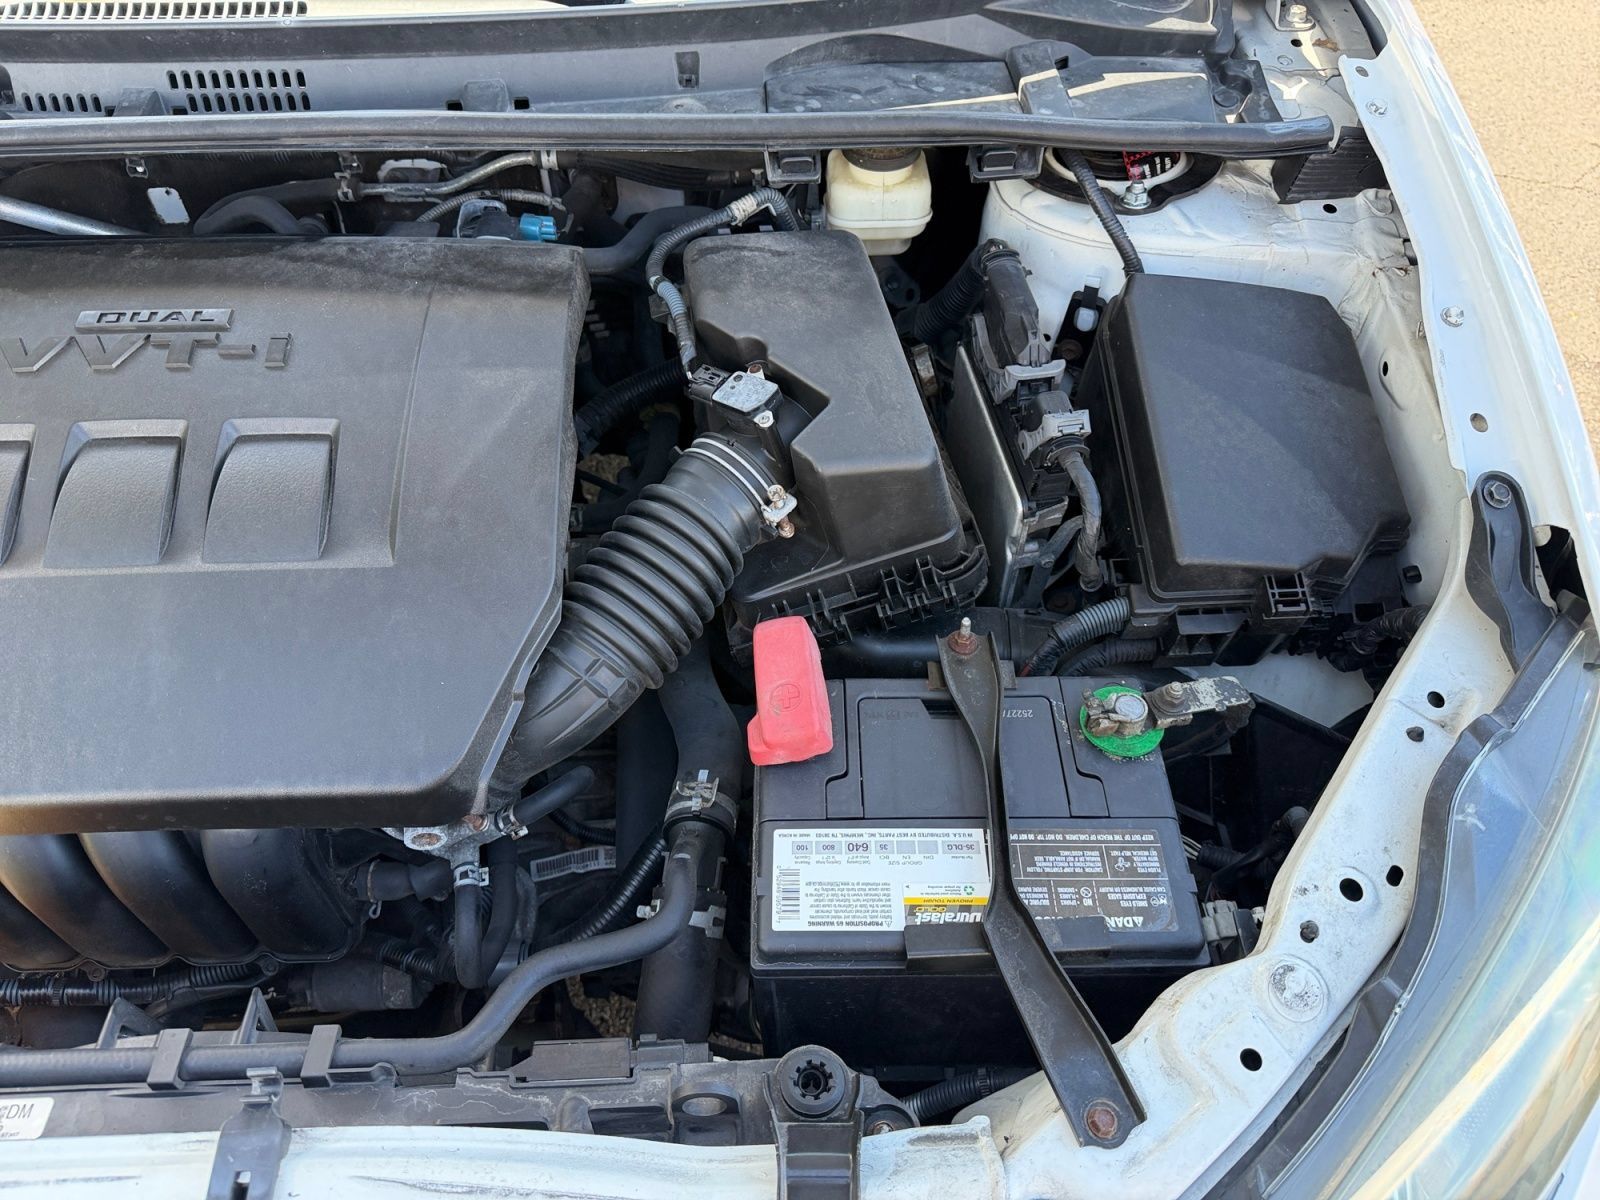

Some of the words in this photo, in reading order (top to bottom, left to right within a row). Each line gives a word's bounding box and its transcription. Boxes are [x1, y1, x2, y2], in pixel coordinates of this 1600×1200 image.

[96, 310, 215, 323] DUAL
[847, 843, 868, 852] 640
[1083, 898, 1093, 906] NO
[1106, 917, 1134, 928] DAN
